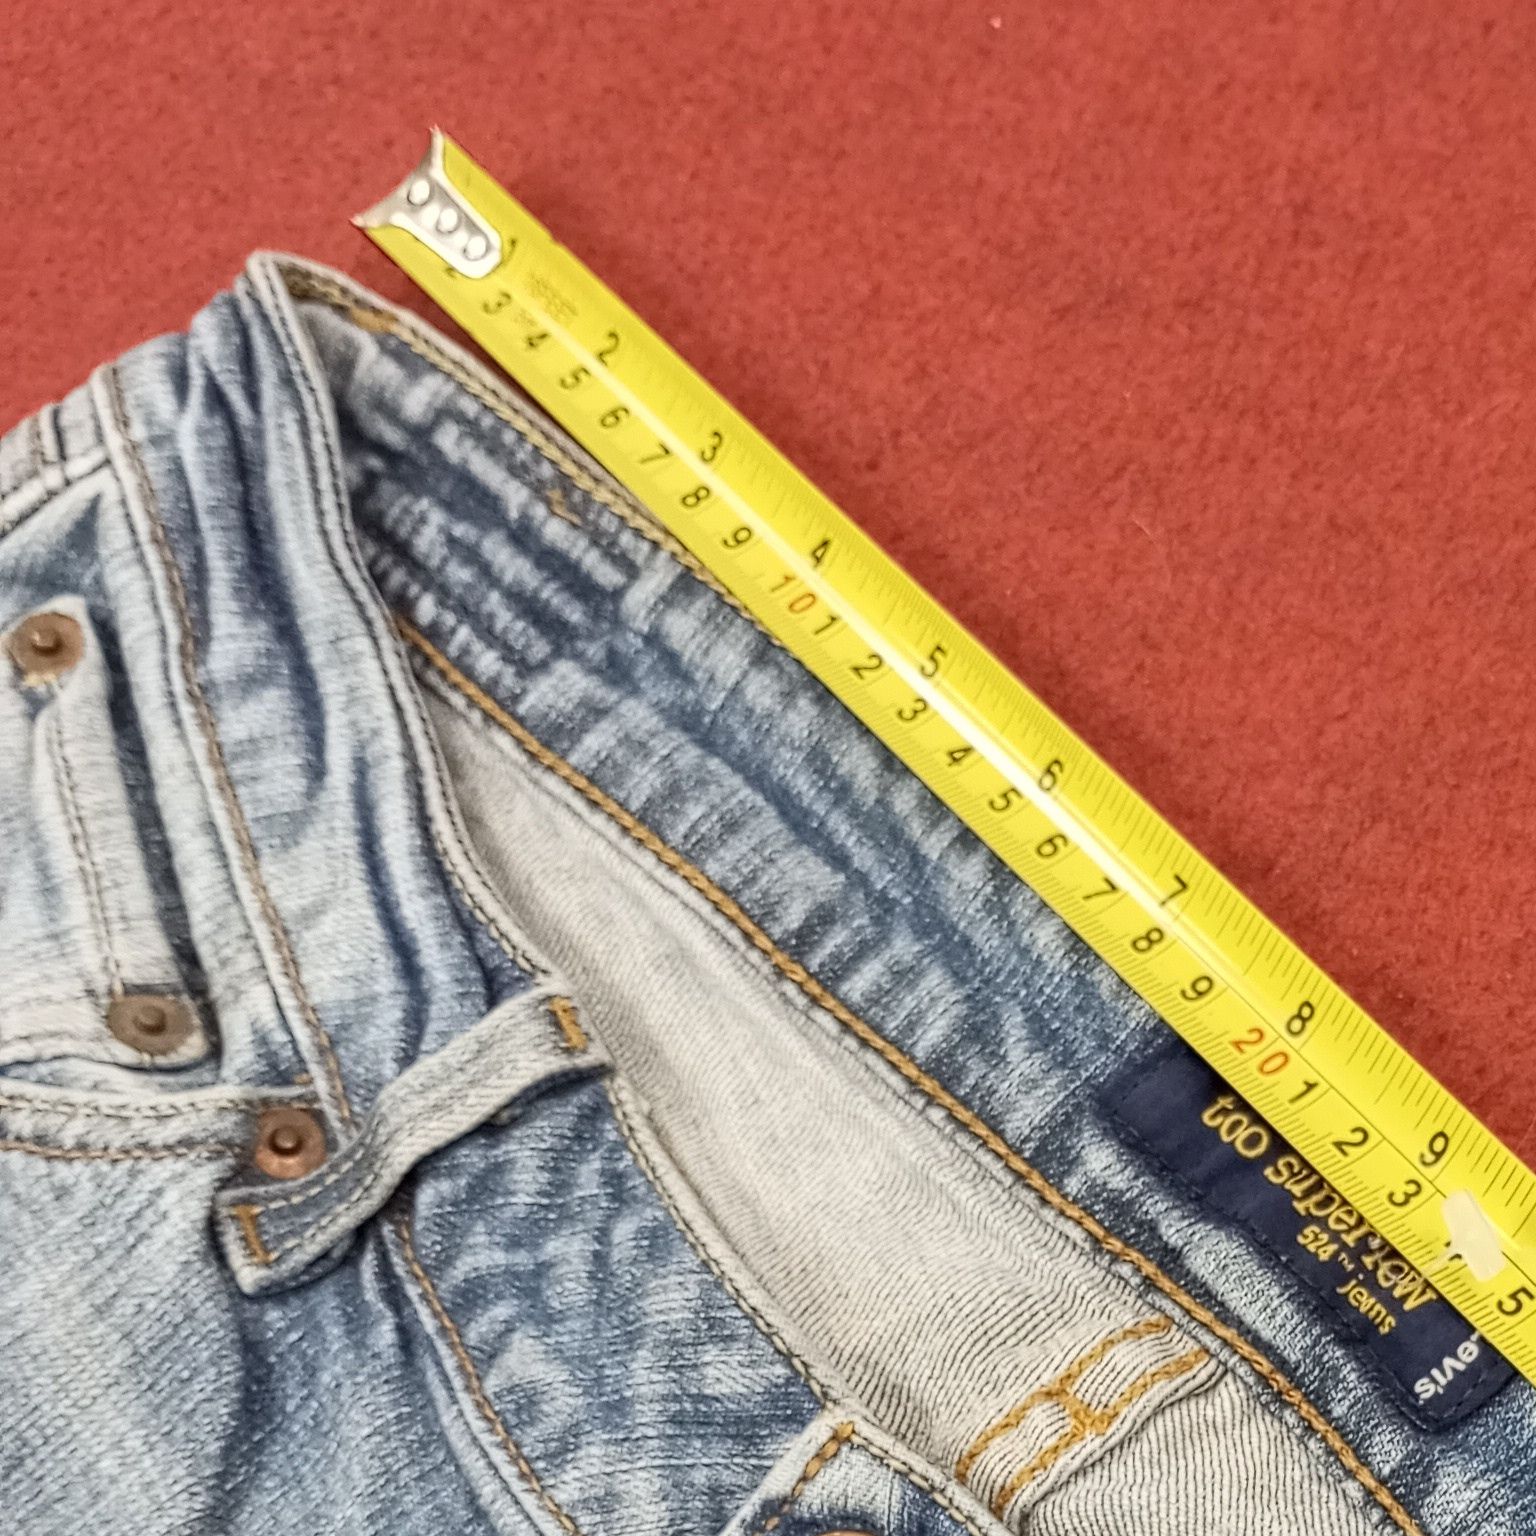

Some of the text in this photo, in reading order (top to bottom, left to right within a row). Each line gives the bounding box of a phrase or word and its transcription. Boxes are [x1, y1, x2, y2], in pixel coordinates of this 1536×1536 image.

[596, 331, 620, 367] 2
[700, 431, 724, 465] 3
[810, 538, 832, 568] 4
[919, 643, 947, 680] 5
[1038, 757, 1065, 793] 6
[1159, 873, 1189, 907] 7
[1285, 999, 1316, 1038] 8
[1418, 1130, 1450, 1168] 9
[559, 367, 591, 391] 5
[599, 405, 630, 430] 6
[640, 443, 673, 465] 7
[680, 485, 710, 509] 8
[721, 526, 753, 551] 9
[769, 574, 817, 614] 10
[812, 614, 842, 635] 1
[851, 653, 883, 680] 2
[896, 698, 928, 723] 3
[944, 746, 975, 769] 4
[988, 787, 1022, 813] 5
[1035, 832, 1068, 860] 6
[1081, 877, 1120, 902] 7
[1130, 926, 1165, 955] 8
[1180, 974, 1214, 1003] 9
[1230, 1027, 1291, 1078] 20
[1287, 1079, 1319, 1105] 1
[1332, 1126, 1369, 1157] 2
[1386, 1178, 1423, 1209] 3
[1497, 1286, 1535, 1316] 5
[1201, 1095, 1270, 1160] too
[1337, 1272, 1397, 1335] jeans
[1413, 1331, 1480, 1401] evi's
